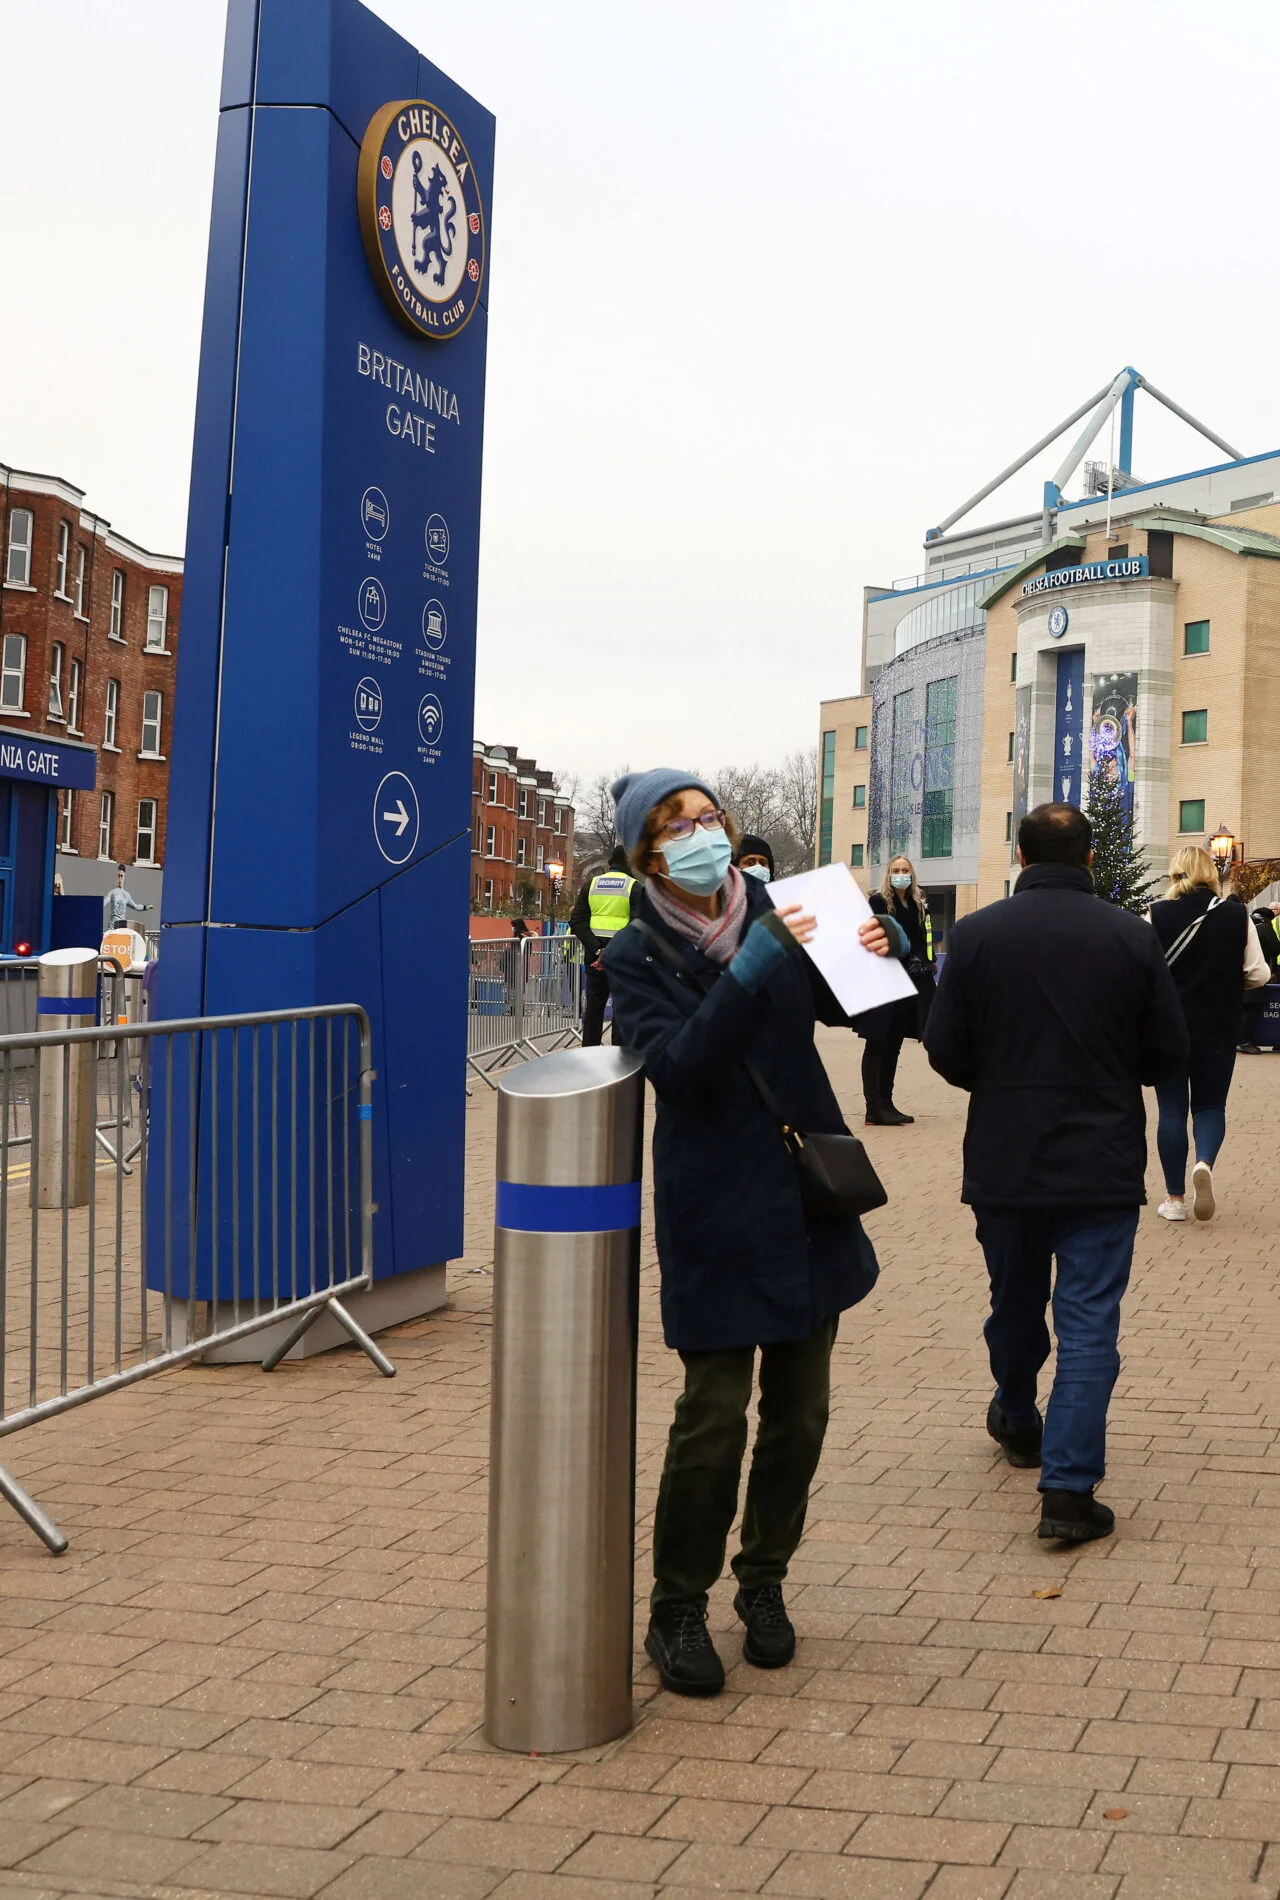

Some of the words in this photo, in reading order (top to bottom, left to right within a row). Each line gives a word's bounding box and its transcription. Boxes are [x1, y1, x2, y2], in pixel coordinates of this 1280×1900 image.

[398, 108, 470, 184] CHELSEA
[391, 264, 439, 326] FOOTBALL
[442, 299, 466, 326] CLUB
[358, 342, 460, 425] BRITANNIA
[386, 402, 436, 454] GATE
[366, 541, 382, 554] HOTEL
[1022, 579, 1049, 596] CHELSEA
[1050, 566, 1104, 587] FOOTBALL
[1106, 560, 1140, 577] CLUB
[338, 626, 362, 638] CHELSEA
[364, 632, 371, 640] FC
[372, 636, 402, 650] MEGASTORE
[27, 750, 59, 776] GATE
